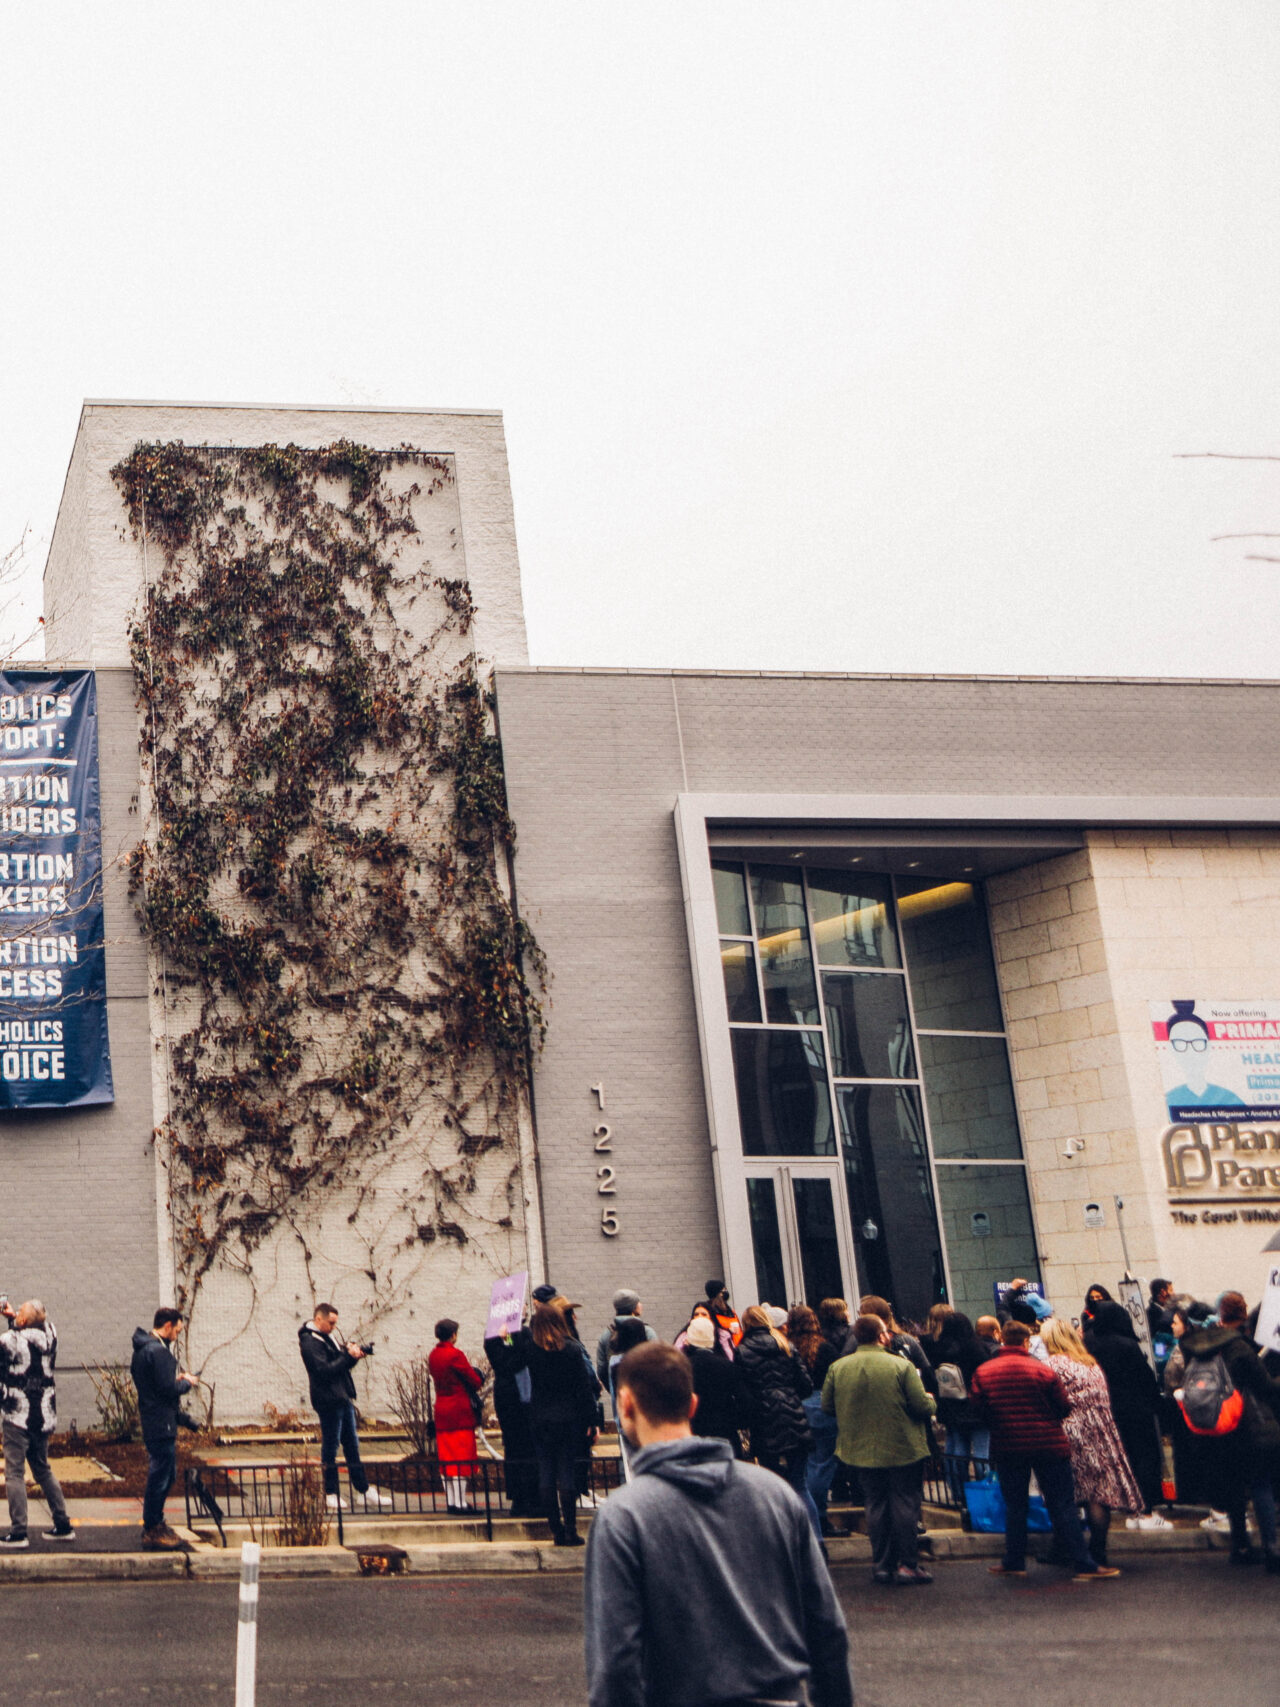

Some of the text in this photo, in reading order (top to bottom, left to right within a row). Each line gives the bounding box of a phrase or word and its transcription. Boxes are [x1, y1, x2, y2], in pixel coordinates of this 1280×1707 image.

[1234, 1009, 1267, 1018] offering
[1214, 1022, 1280, 1039] PRIMA
[1170, 1210, 1197, 1223] The
